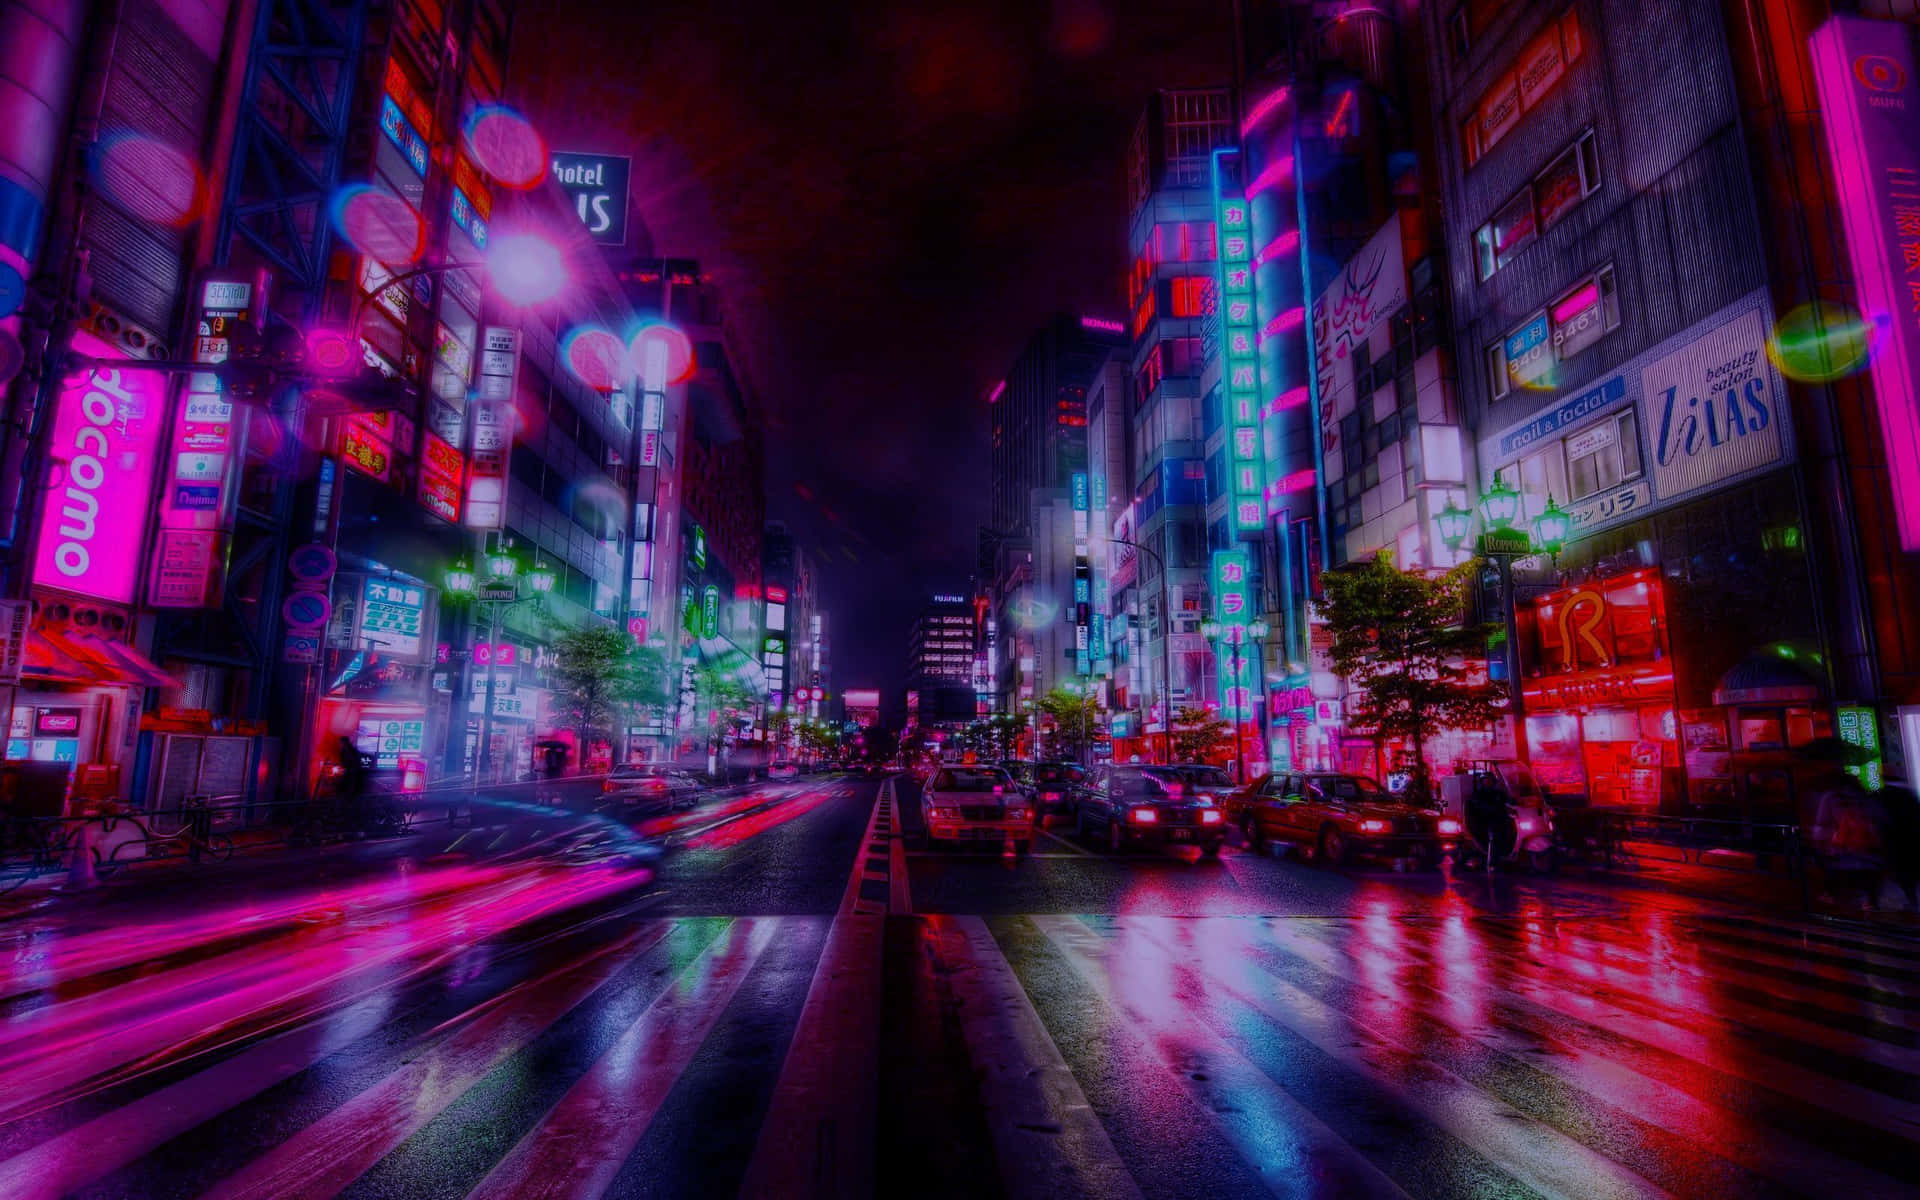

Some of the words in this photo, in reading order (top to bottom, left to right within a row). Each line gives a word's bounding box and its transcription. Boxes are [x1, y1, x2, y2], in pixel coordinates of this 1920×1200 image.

[552, 161, 604, 186] hotel
[1705, 348, 1759, 382] beauty
[1710, 367, 1755, 395] salon
[1511, 421, 1544, 449] nail
[1545, 421, 1555, 433] &
[1556, 386, 1609, 428] facial
[54, 367, 132, 577] docomo
[1558, 590, 1609, 673] R
[476, 679, 507, 689] DRGS
